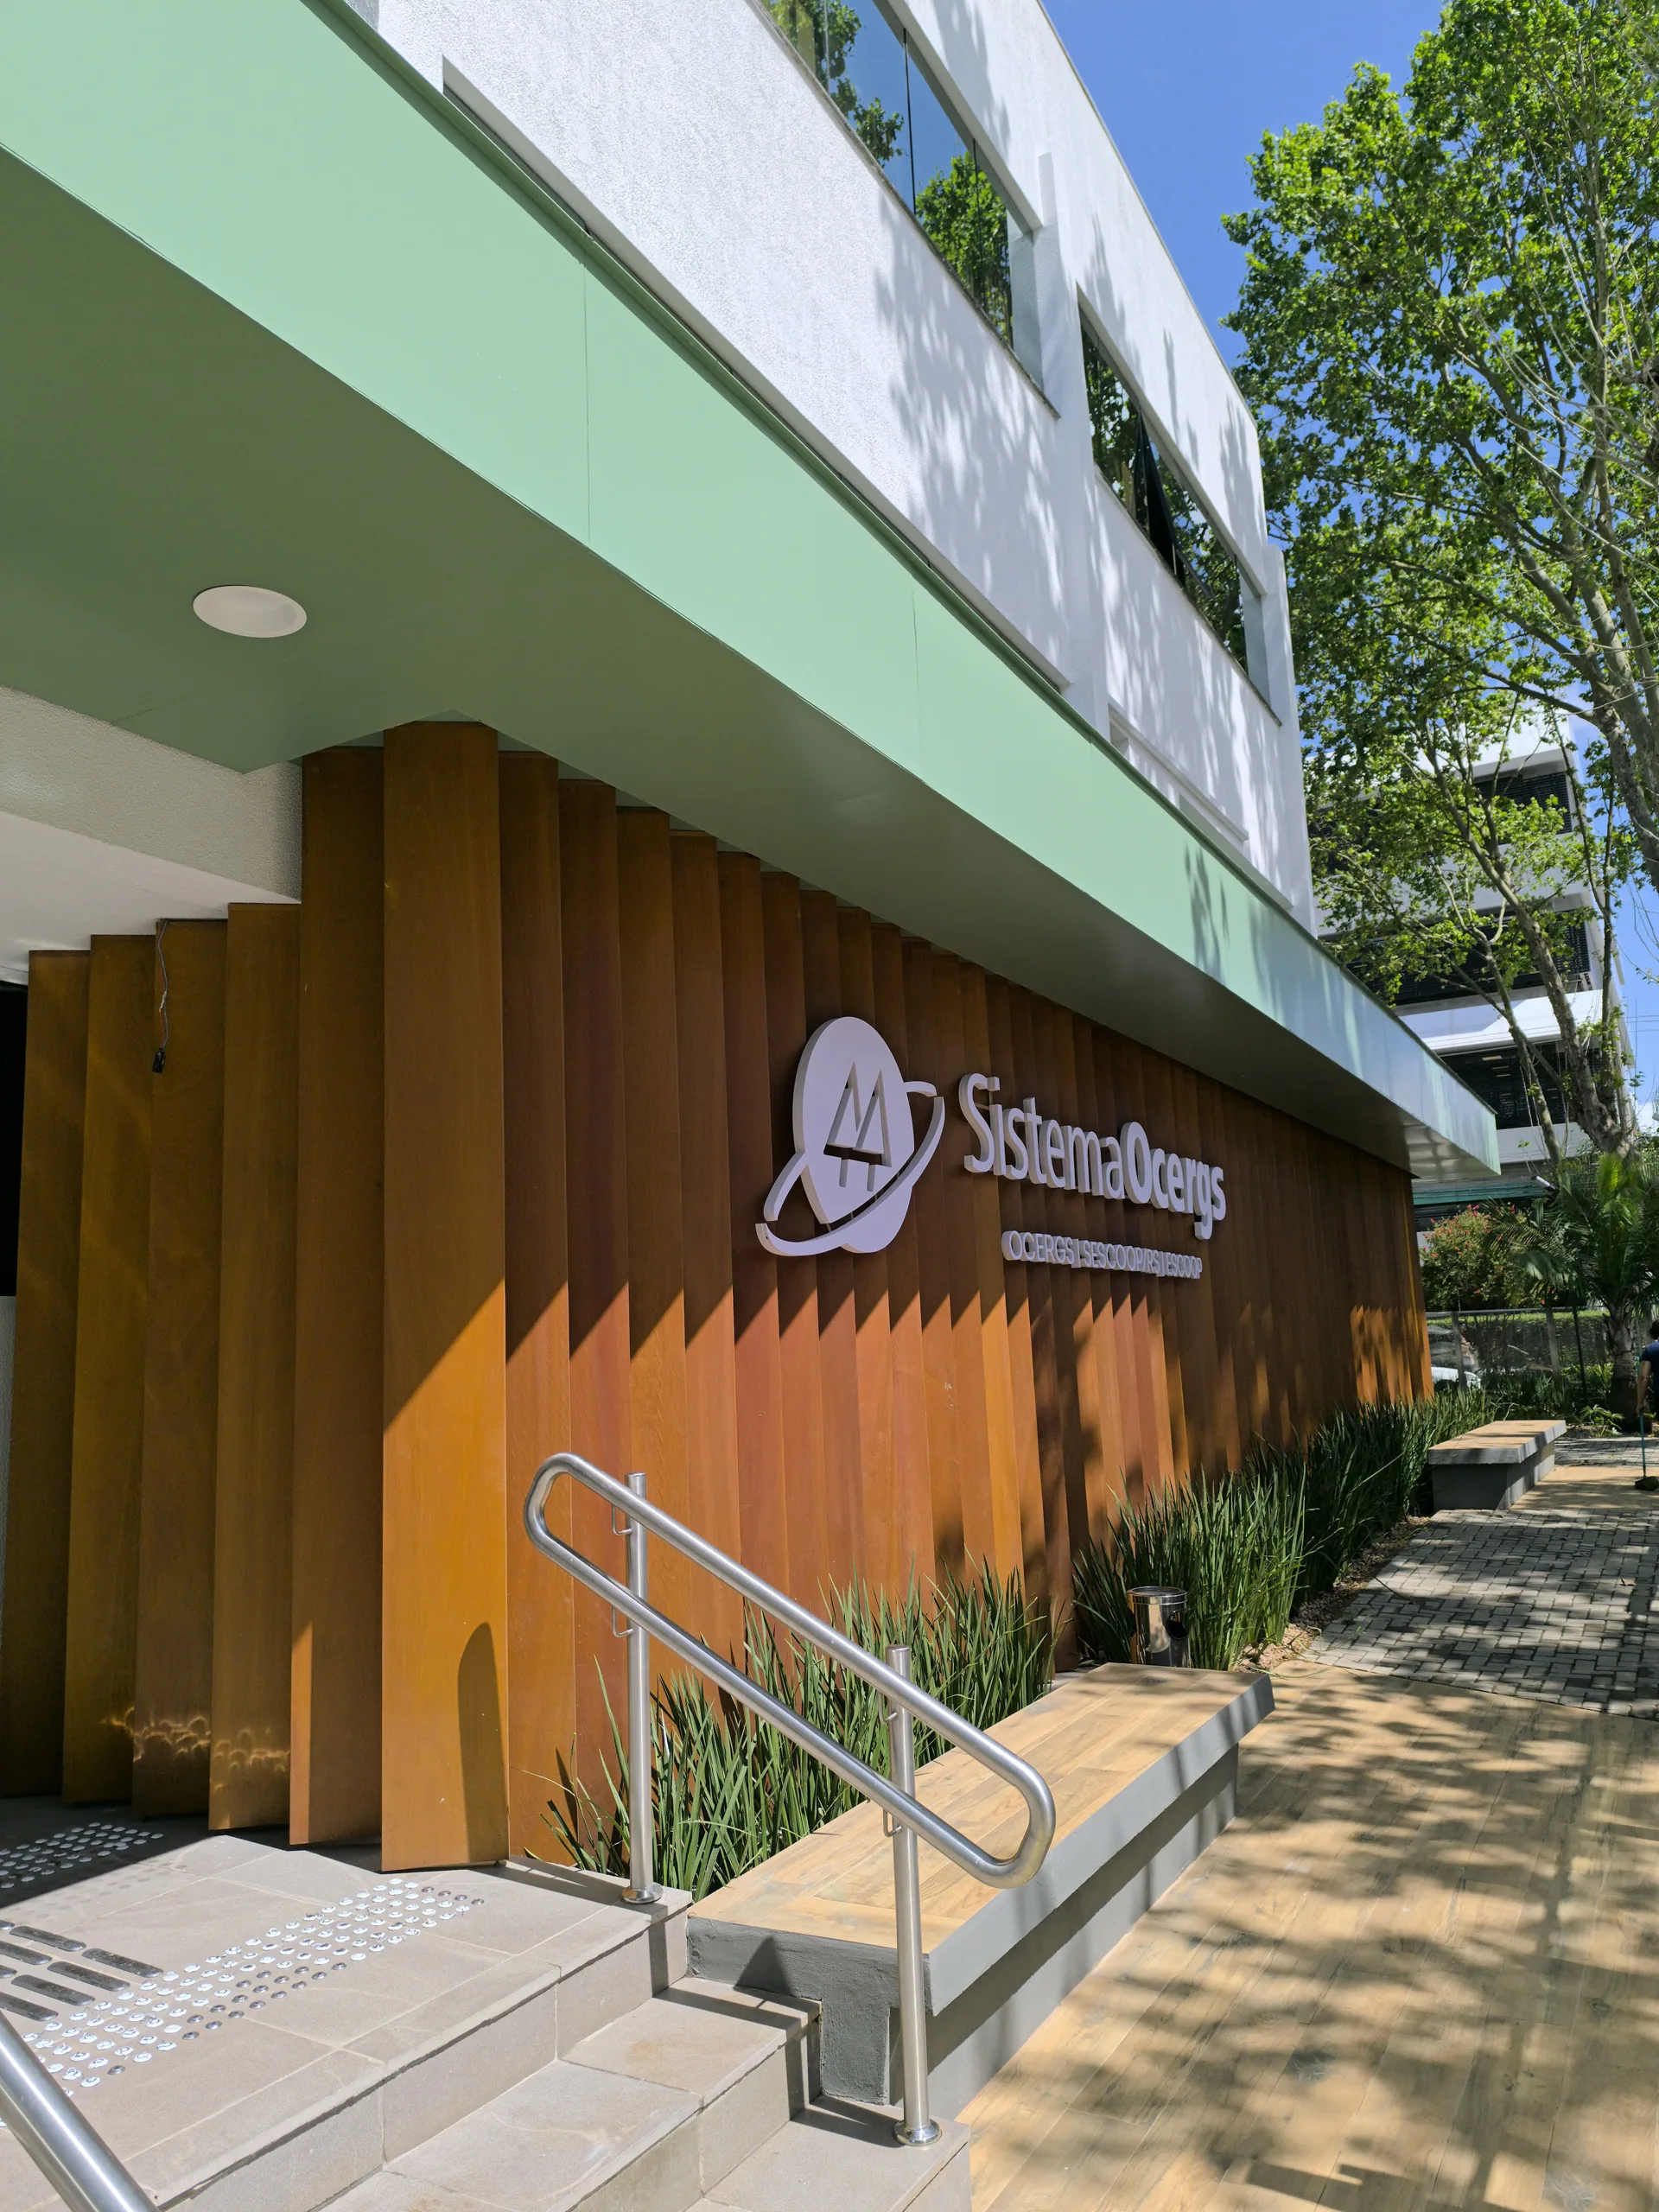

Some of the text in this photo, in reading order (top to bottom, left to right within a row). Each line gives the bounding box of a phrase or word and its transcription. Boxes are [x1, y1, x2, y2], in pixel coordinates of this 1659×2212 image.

[958, 1072, 1226, 1240] SistemaOcergs
[1001, 1230, 1075, 1265] OCERGS
[1080, 1240, 1160, 1274] SESCOOP/RS
[1164, 1252, 1203, 1279] ESCOOP
